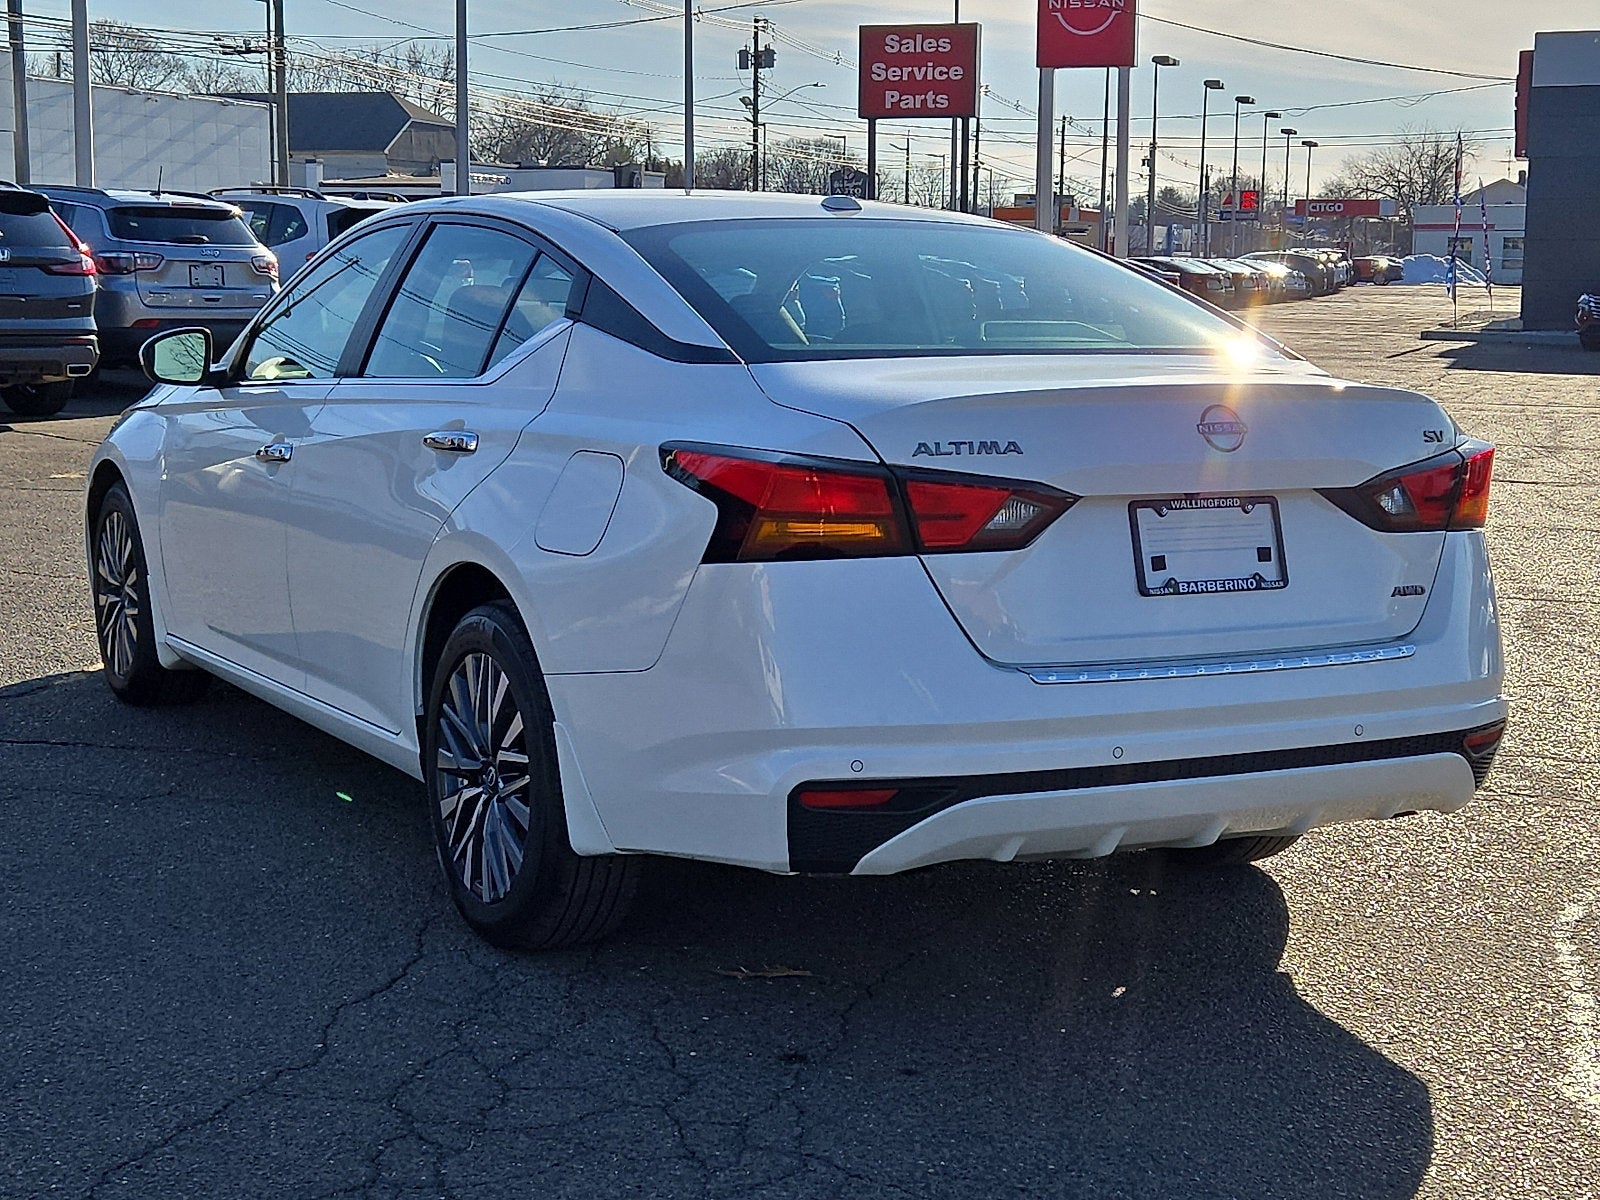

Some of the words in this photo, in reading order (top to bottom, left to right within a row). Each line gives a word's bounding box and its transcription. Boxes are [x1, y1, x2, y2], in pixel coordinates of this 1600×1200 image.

[1049, 0, 1124, 9] NISSAN
[884, 34, 952, 53] Sales
[871, 62, 964, 81] Service
[885, 90, 949, 109] Parts
[1309, 202, 1344, 212] CITGO
[200, 249, 220, 258] Jeep
[1423, 430, 1443, 443] SV
[912, 440, 1024, 457] ALTIMA
[1170, 498, 1240, 509] WALLINGFORD
[1149, 587, 1174, 595] NISSAN
[1179, 578, 1257, 593] BARBERINO
[1390, 585, 1426, 598] AWD
